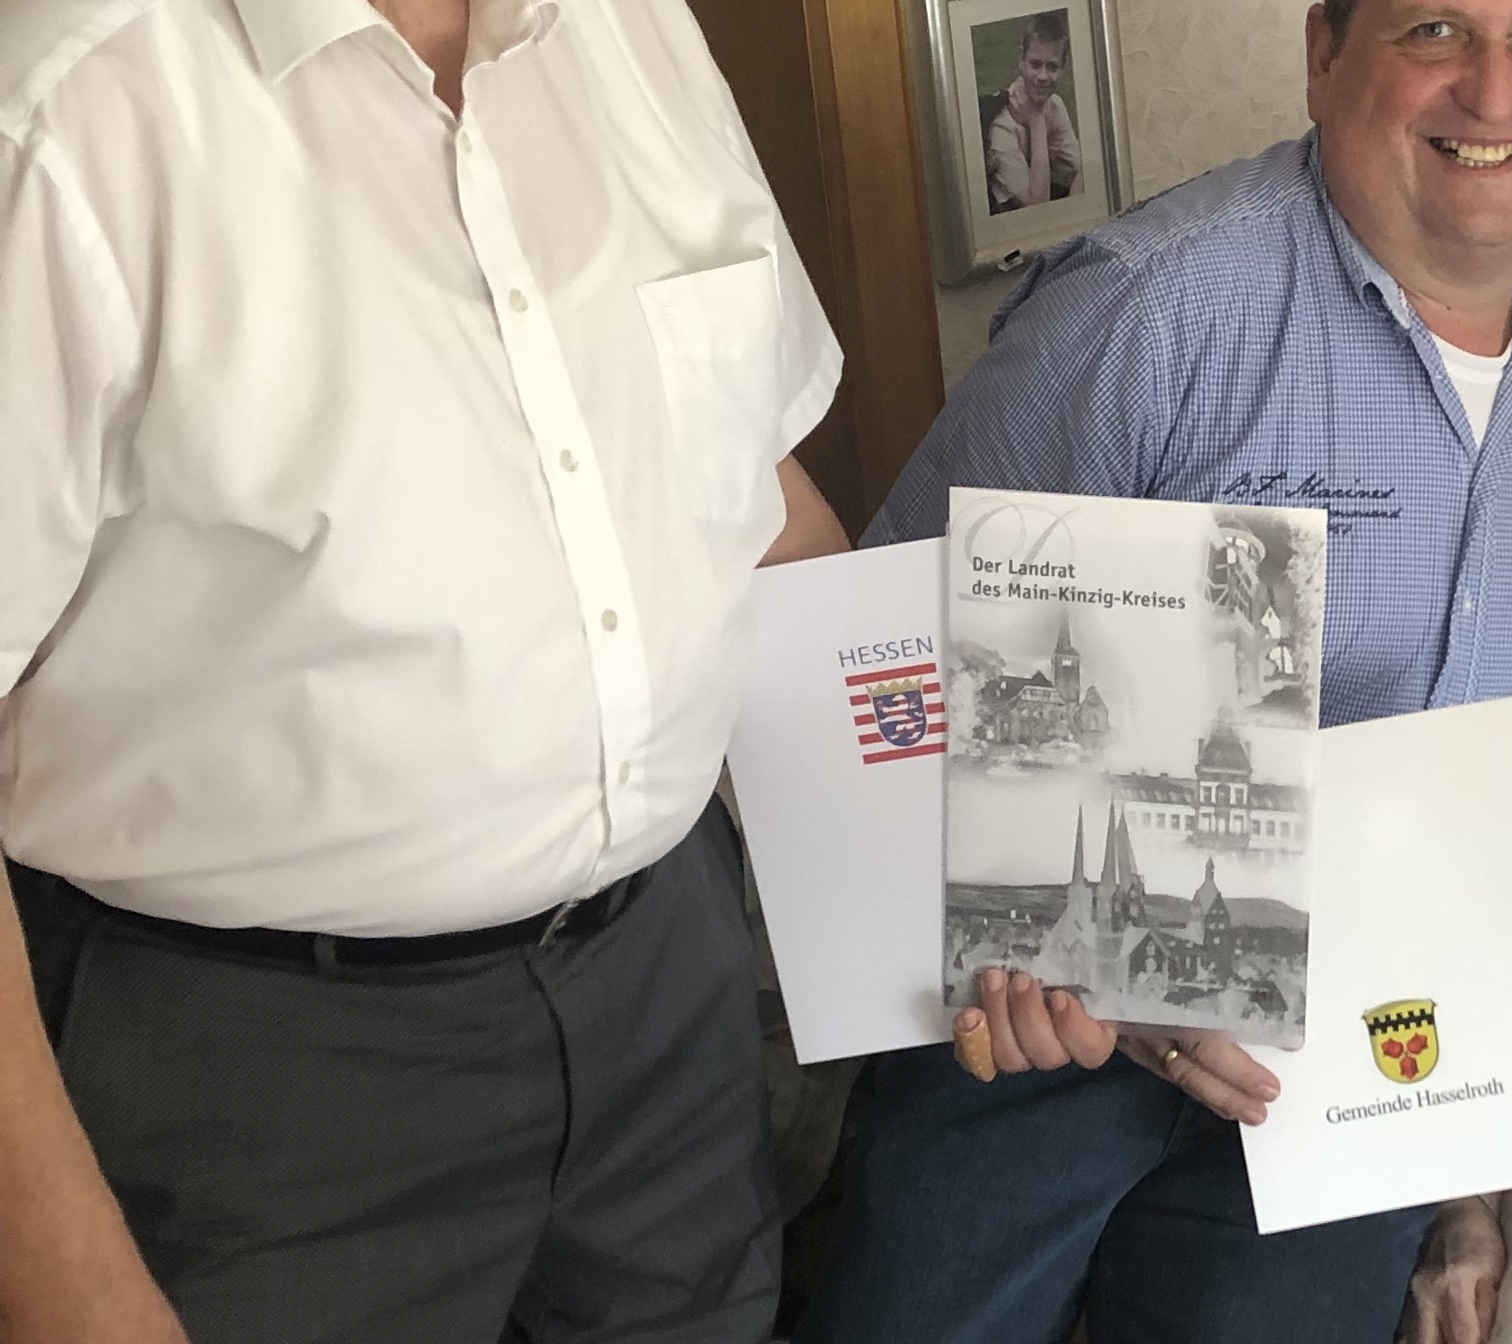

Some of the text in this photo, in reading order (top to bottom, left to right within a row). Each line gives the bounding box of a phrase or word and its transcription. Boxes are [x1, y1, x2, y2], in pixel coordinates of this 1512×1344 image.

[972, 556, 1076, 579] Der Landrat
[972, 580, 1186, 610] des Main-Kinzig-Kreises
[838, 635, 934, 668] HESSEN
[1326, 1077, 1505, 1124] Gemeinde Hasselroth
